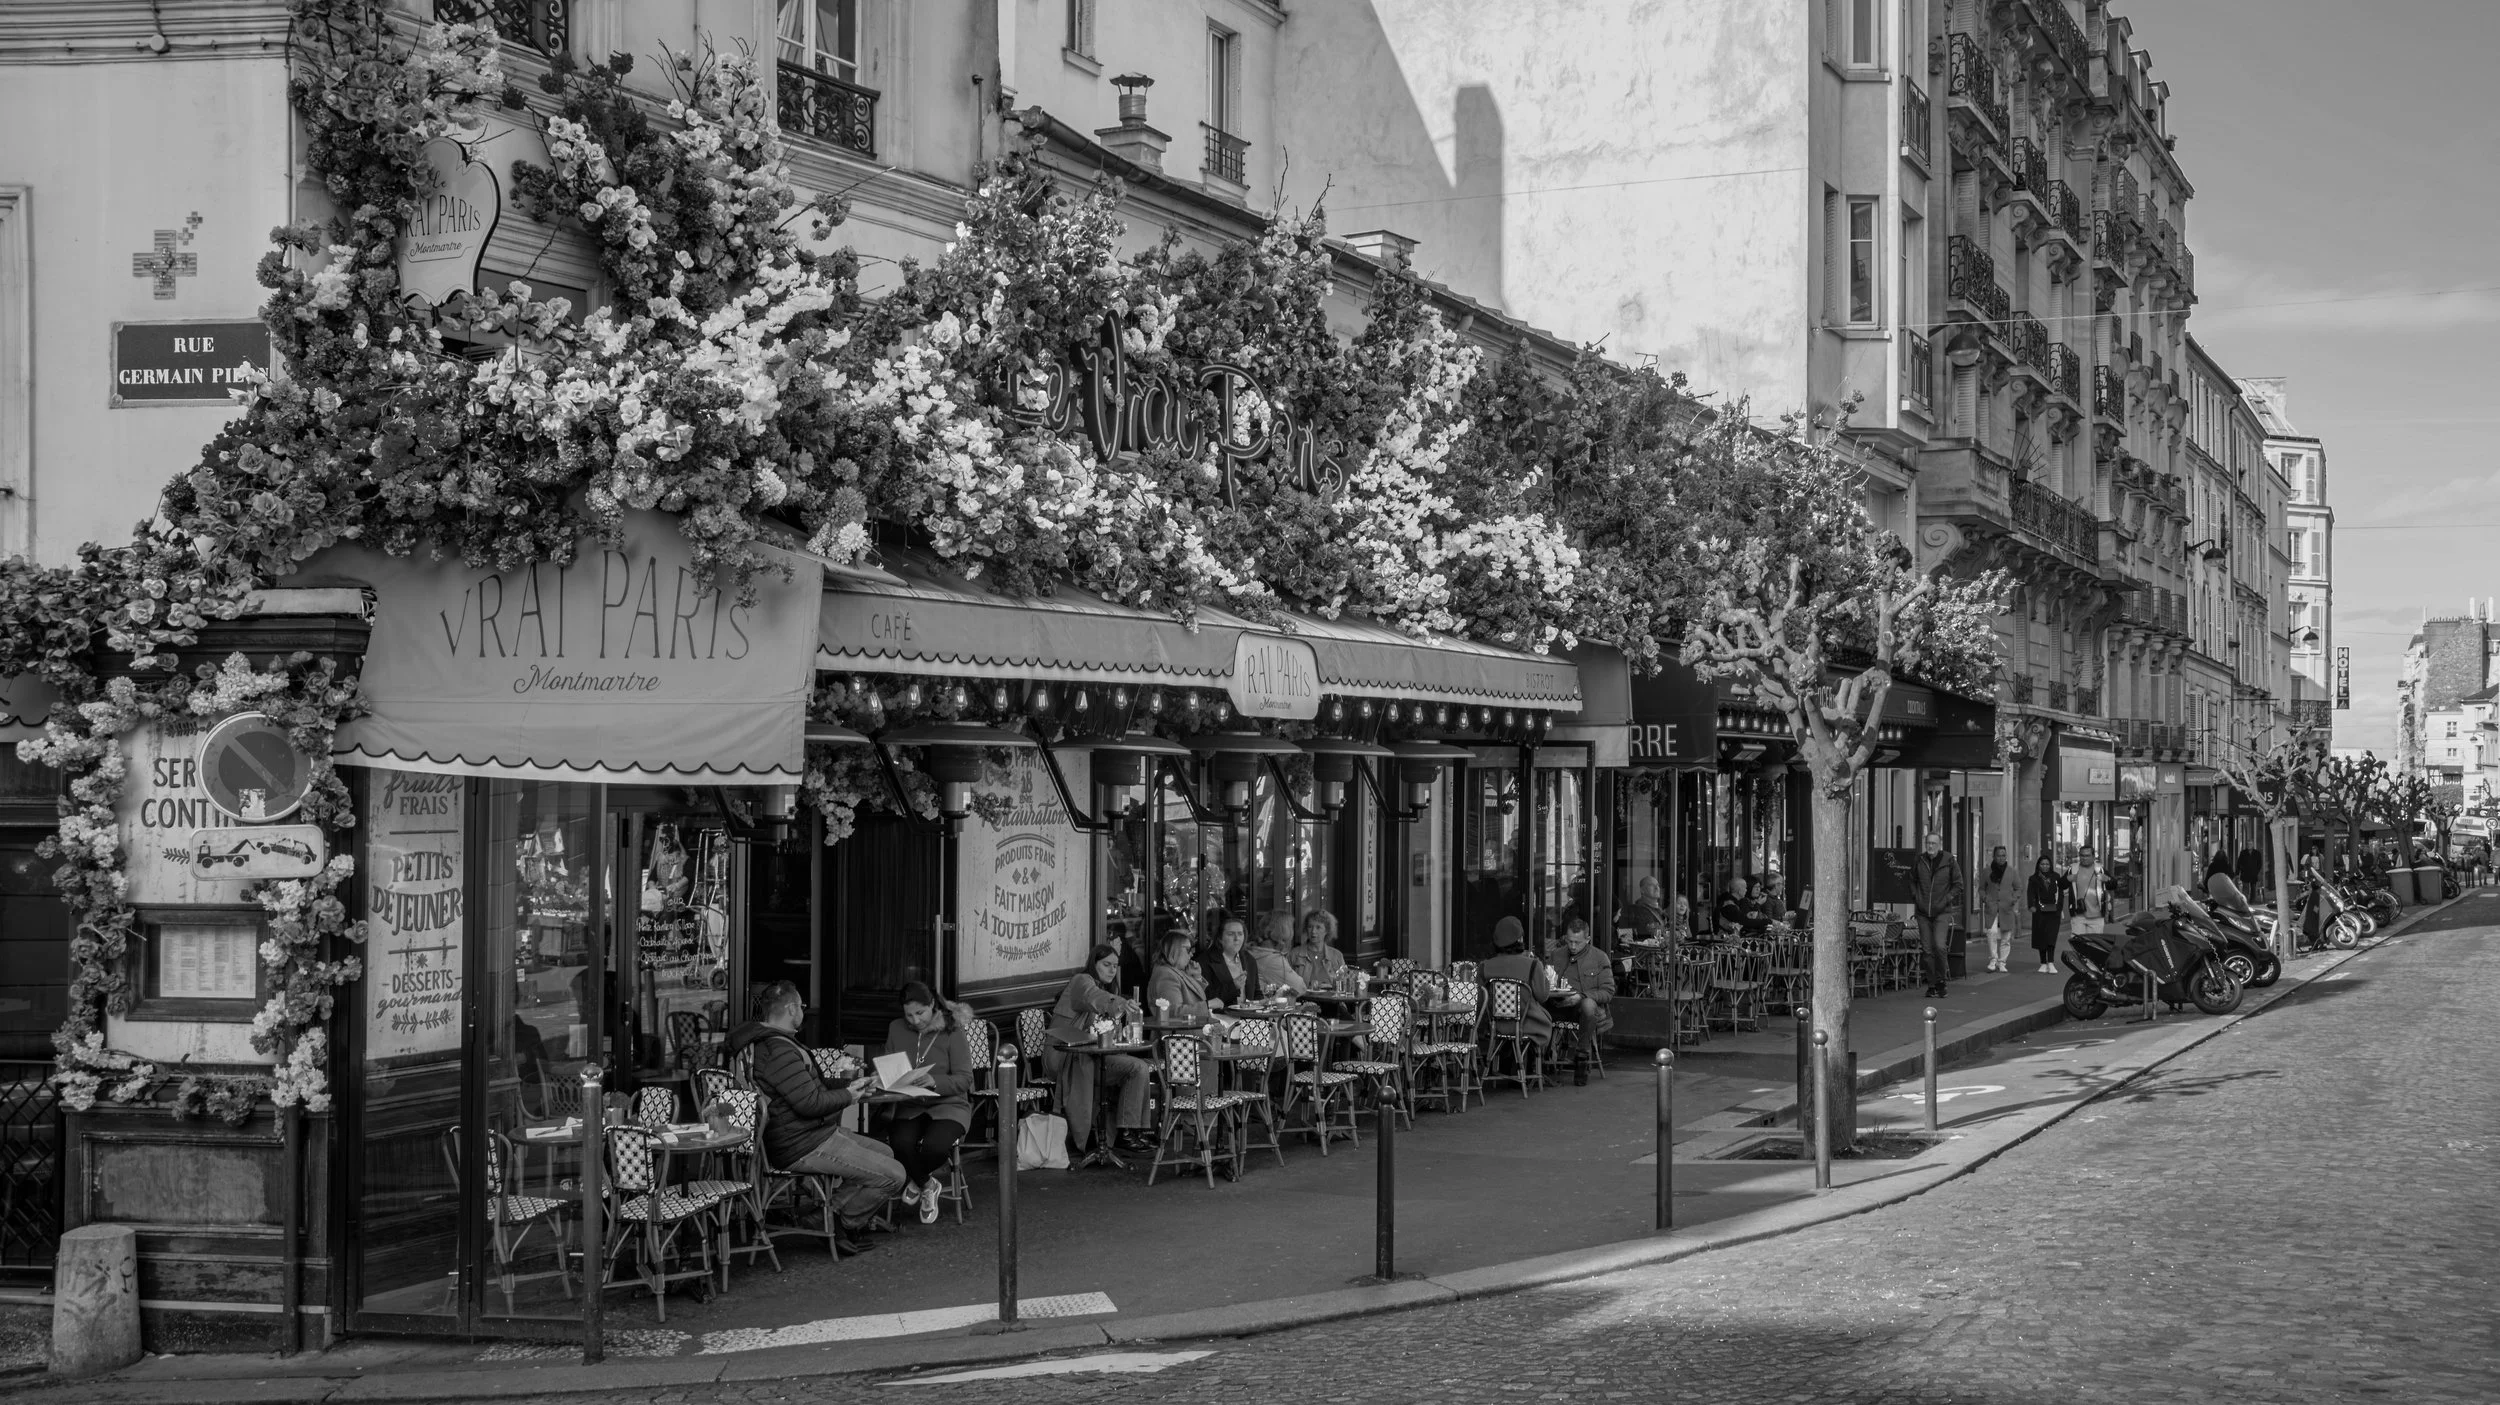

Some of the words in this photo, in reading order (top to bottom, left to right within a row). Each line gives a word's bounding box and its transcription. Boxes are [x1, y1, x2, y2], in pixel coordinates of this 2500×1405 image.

[438, 194, 481, 234] PARIS
[409, 241, 463, 257] Montmartre
[173, 336, 215, 353] RUE
[119, 368, 204, 385] GERMAIN
[439, 560, 565, 659] VRAI
[599, 549, 750, 661] PARIS
[871, 612, 912, 642] CAFÉ
[512, 664, 662, 694] Montmartre
[1276, 645, 1311, 698] PARIS
[1526, 672, 1554, 690] BISTROT
[2337, 647, 2349, 697] HOTEL
[1629, 724, 1678, 757] RRE
[152, 757, 197, 789] SER
[1020, 770, 1033, 794] 18
[400, 796, 449, 816] FRAIS
[392, 851, 454, 883] PETITS
[994, 845, 1033, 874] PRODUITS
[1034, 846, 1056, 869] FRAIS
[1021, 866, 1030, 885] &
[994, 884, 1018, 913] FAIT
[1018, 881, 1055, 913] MAISON
[991, 914, 1030, 940] TOUTE
[1031, 900, 1068, 937] HEURE
[392, 968, 454, 995] DESSERTS
